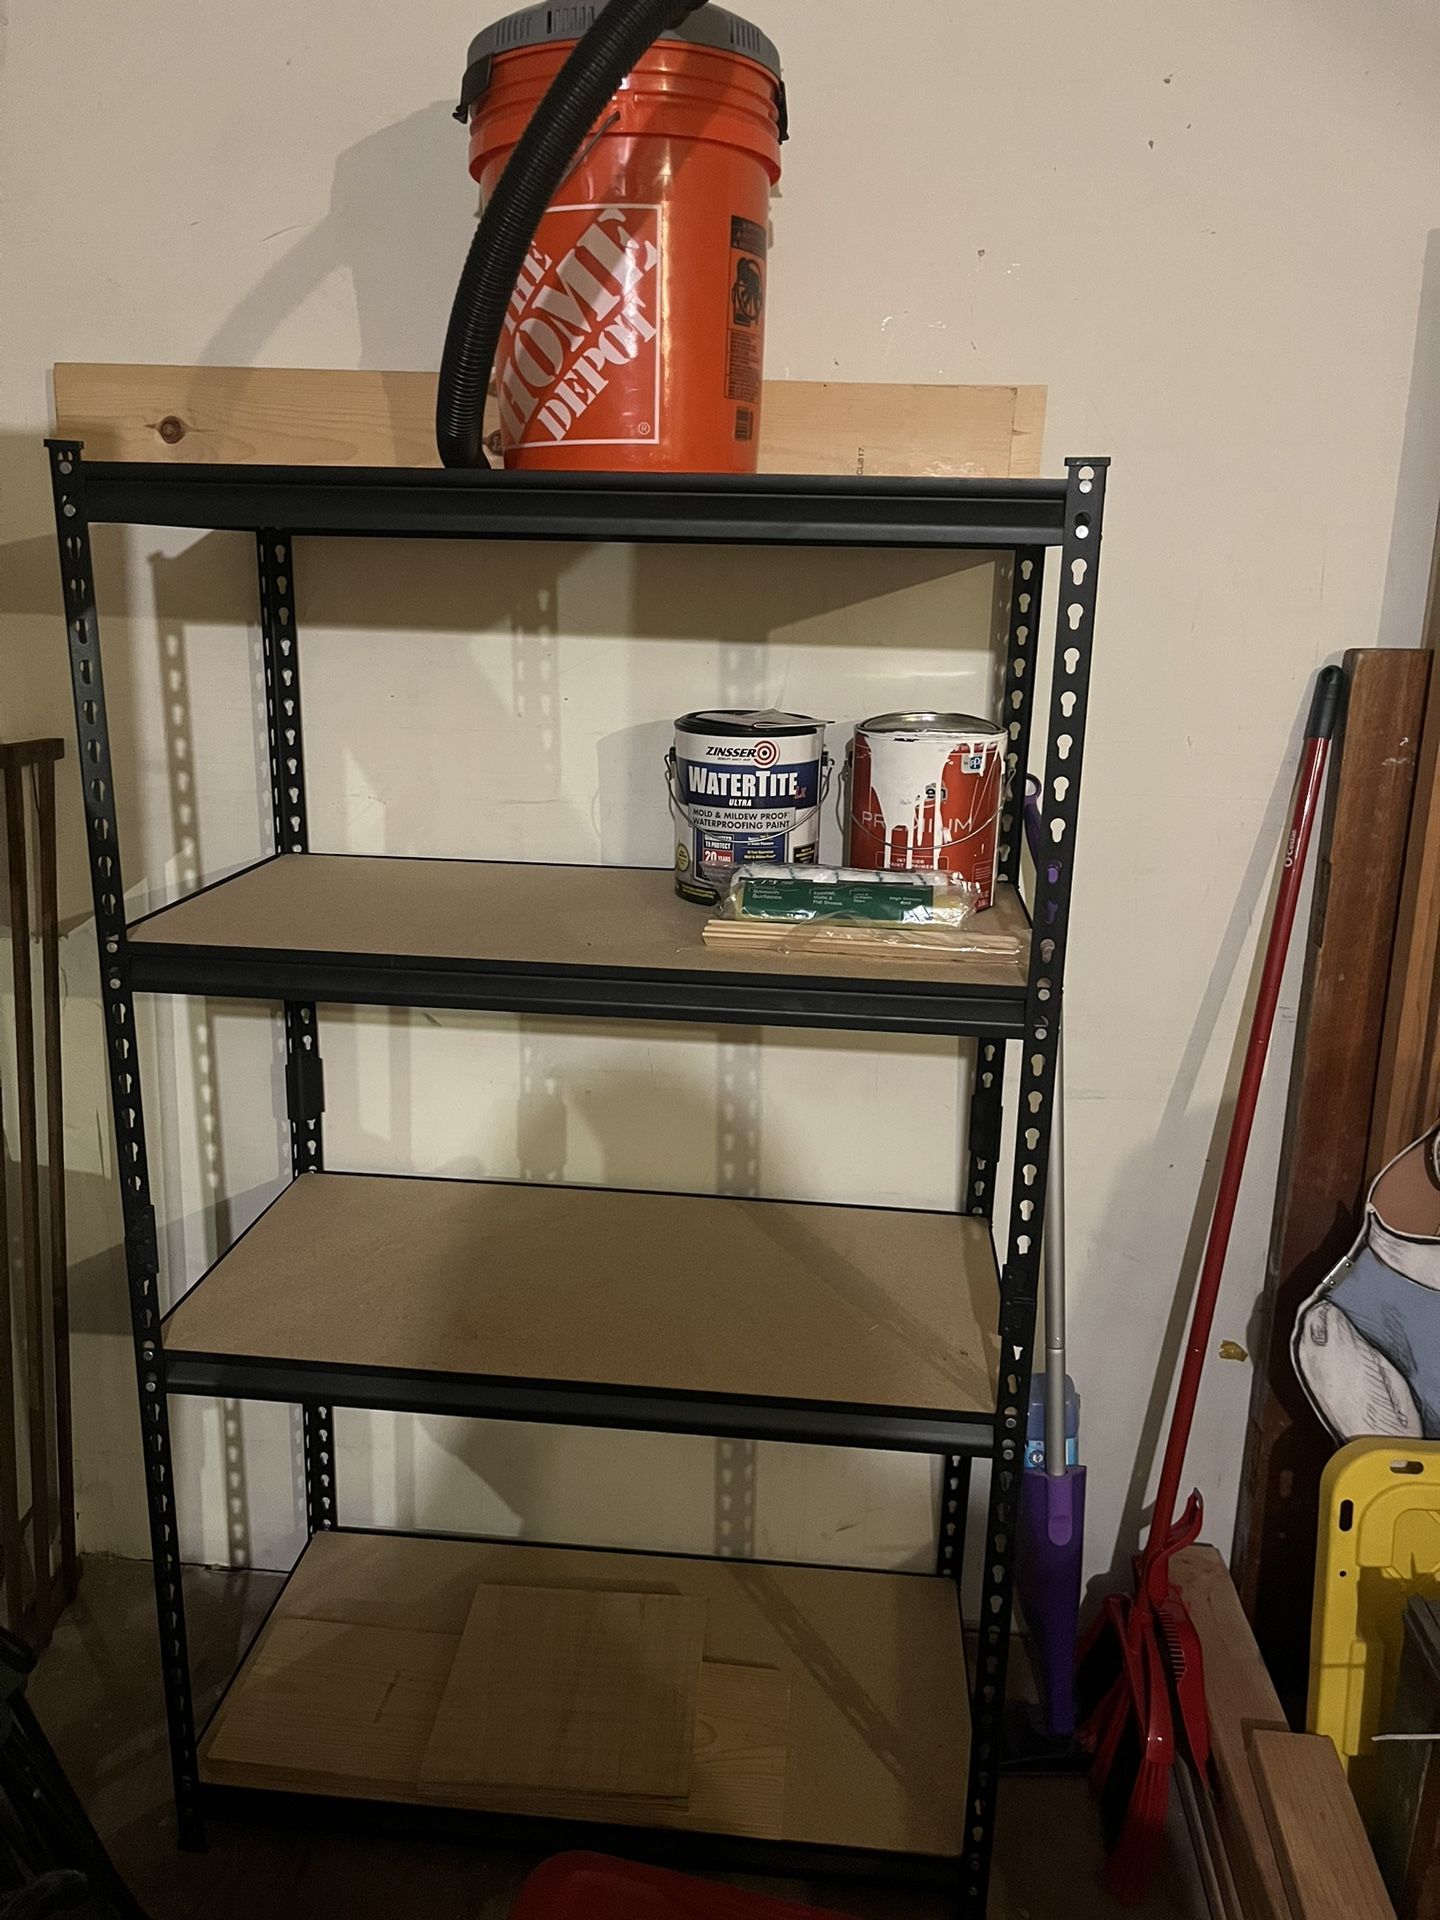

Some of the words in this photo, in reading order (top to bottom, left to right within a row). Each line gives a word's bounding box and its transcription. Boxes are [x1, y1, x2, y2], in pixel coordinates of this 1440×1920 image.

[501, 207, 659, 444] HOME
[537, 288, 657, 442] DEPOT
[706, 746, 757, 758] ZINSSER
[729, 799, 752, 807] ULTRA
[693, 808, 713, 818] MOLD
[724, 812, 758, 820] MILDEW
[693, 817, 764, 830] WATERPROOFING
[766, 820, 790, 829] PAINT
[711, 841, 731, 850] PROTECT
[705, 850, 717, 862] 20
